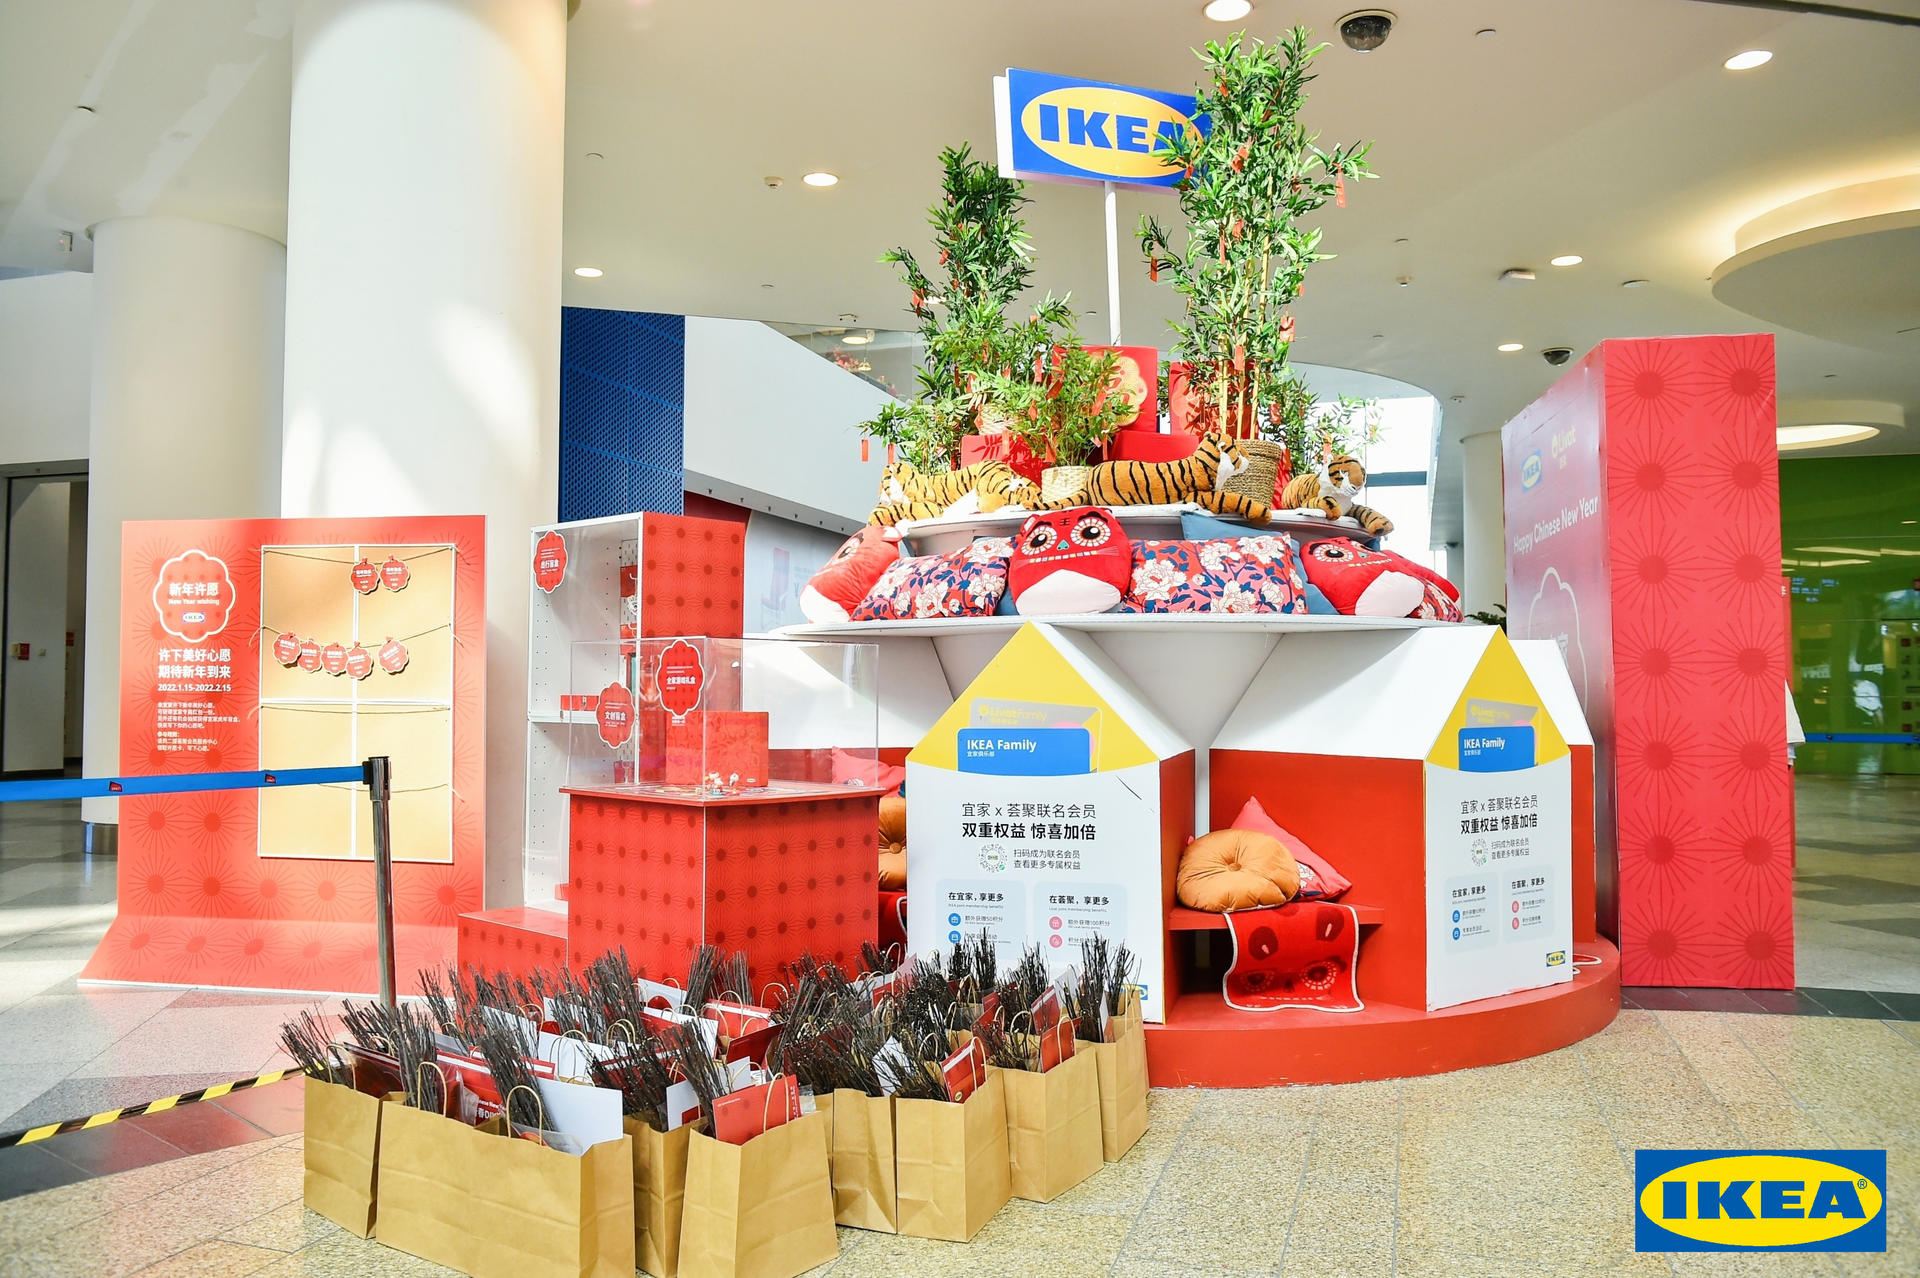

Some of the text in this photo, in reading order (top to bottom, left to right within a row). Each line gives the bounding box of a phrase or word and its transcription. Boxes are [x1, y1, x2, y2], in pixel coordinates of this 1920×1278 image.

[1524, 461, 1540, 481] IKEA
[1514, 496, 1598, 554] Happy Chinese New Year
[169, 582, 219, 596] 新年许愿
[158, 648, 231, 662] 许下美好心愿
[158, 665, 231, 678] 期待新年到来
[967, 739, 1037, 752] IKEA Family
[1464, 737, 1506, 750] IKEA Family
[962, 803, 990, 817] 宜家
[1007, 803, 1096, 819] 荟聚联名会员
[1461, 800, 1478, 814] 宜家
[1488, 794, 1537, 812] 荟聚联名会员
[1461, 813, 1537, 834] 双重权益 惊喜加倍
[962, 822, 1096, 840] 双重权益 惊喜加倍
[1014, 849, 1080, 859] 扫码成为联名会员
[1014, 860, 1081, 870] 查看更多专属权益
